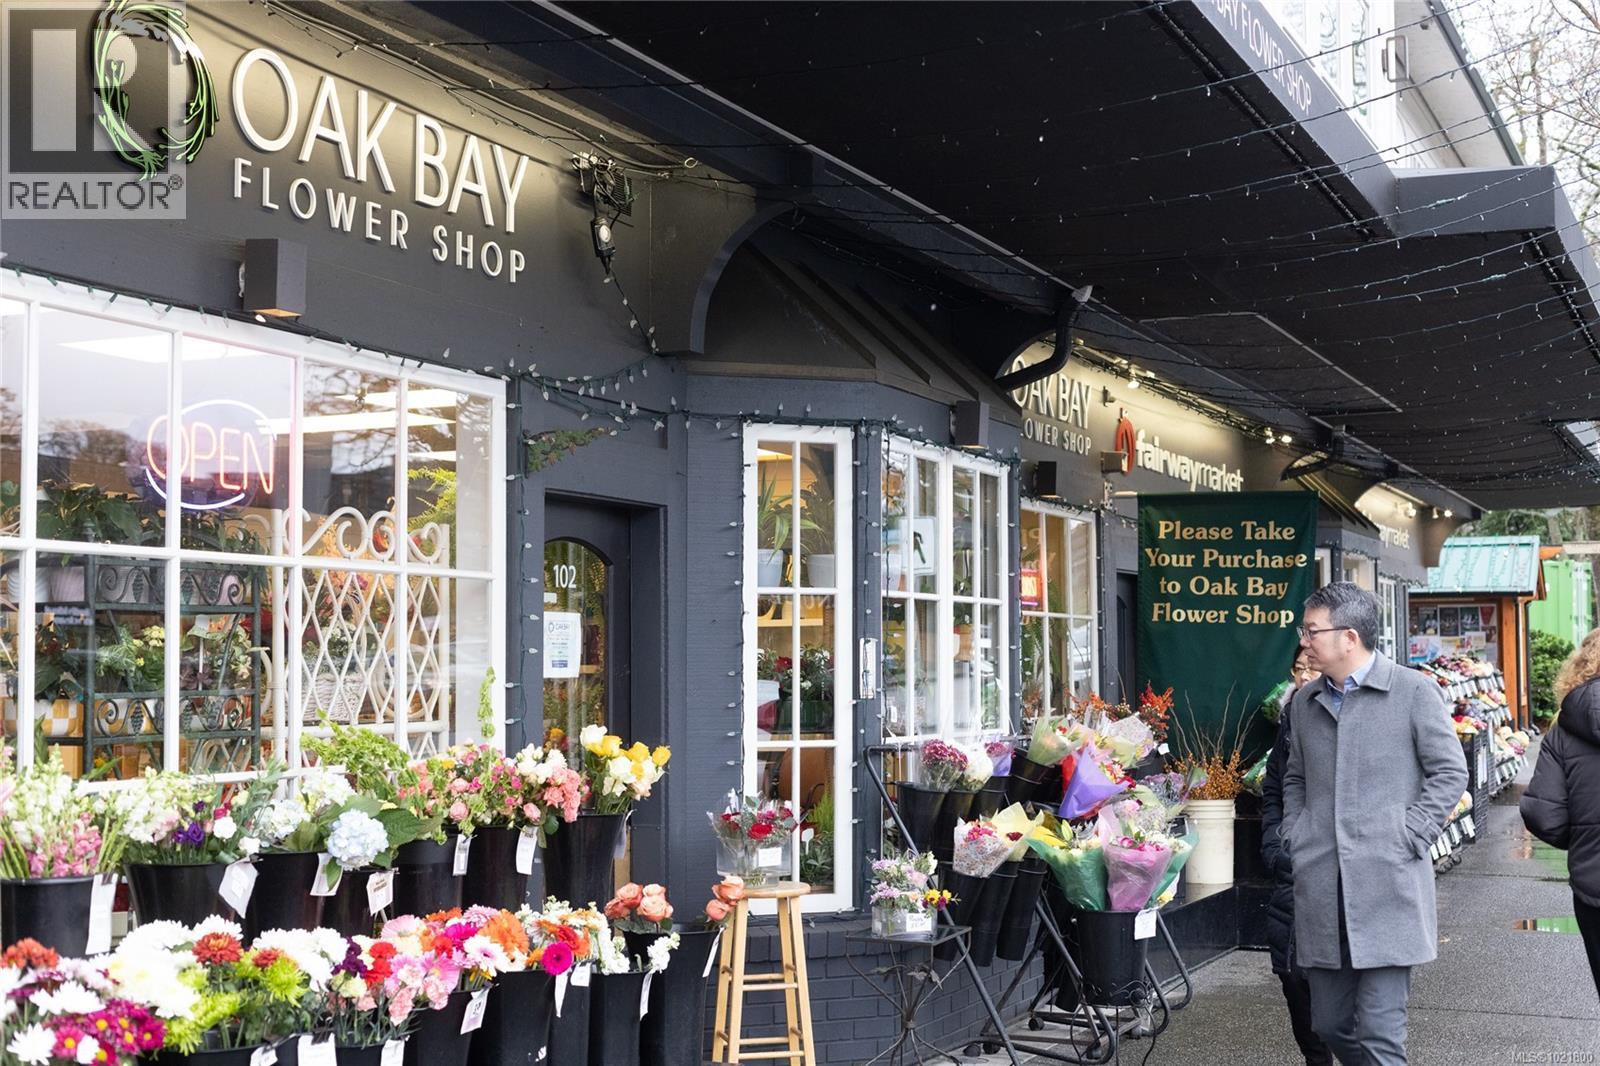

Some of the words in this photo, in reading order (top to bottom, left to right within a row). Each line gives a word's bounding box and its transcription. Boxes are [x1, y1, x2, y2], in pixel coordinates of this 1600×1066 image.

[1241, 2, 1285, 88] FLOWER
[1286, 60, 1312, 115] SHOP
[232, 48, 397, 193] OAK
[415, 113, 530, 233] BAY
[234, 157, 409, 250] FLOWER
[432, 225, 526, 283] SHOP
[1058, 373, 1092, 430] BAY
[147, 414, 275, 495] OPEN
[1020, 417, 1059, 447] OWER
[1062, 430, 1092, 456] SHOP
[1157, 520, 1233, 541] Please
[1241, 520, 1295, 541] Take
[553, 564, 577, 589] 102
[1145, 547, 1196, 568] Your
[1203, 549, 1308, 569] Purchase
[1159, 577, 1182, 594] to
[1189, 575, 1238, 596] Oak
[1246, 576, 1288, 600] Bay
[1151, 602, 1229, 624] Flower
[1235, 604, 1295, 628] Shop
